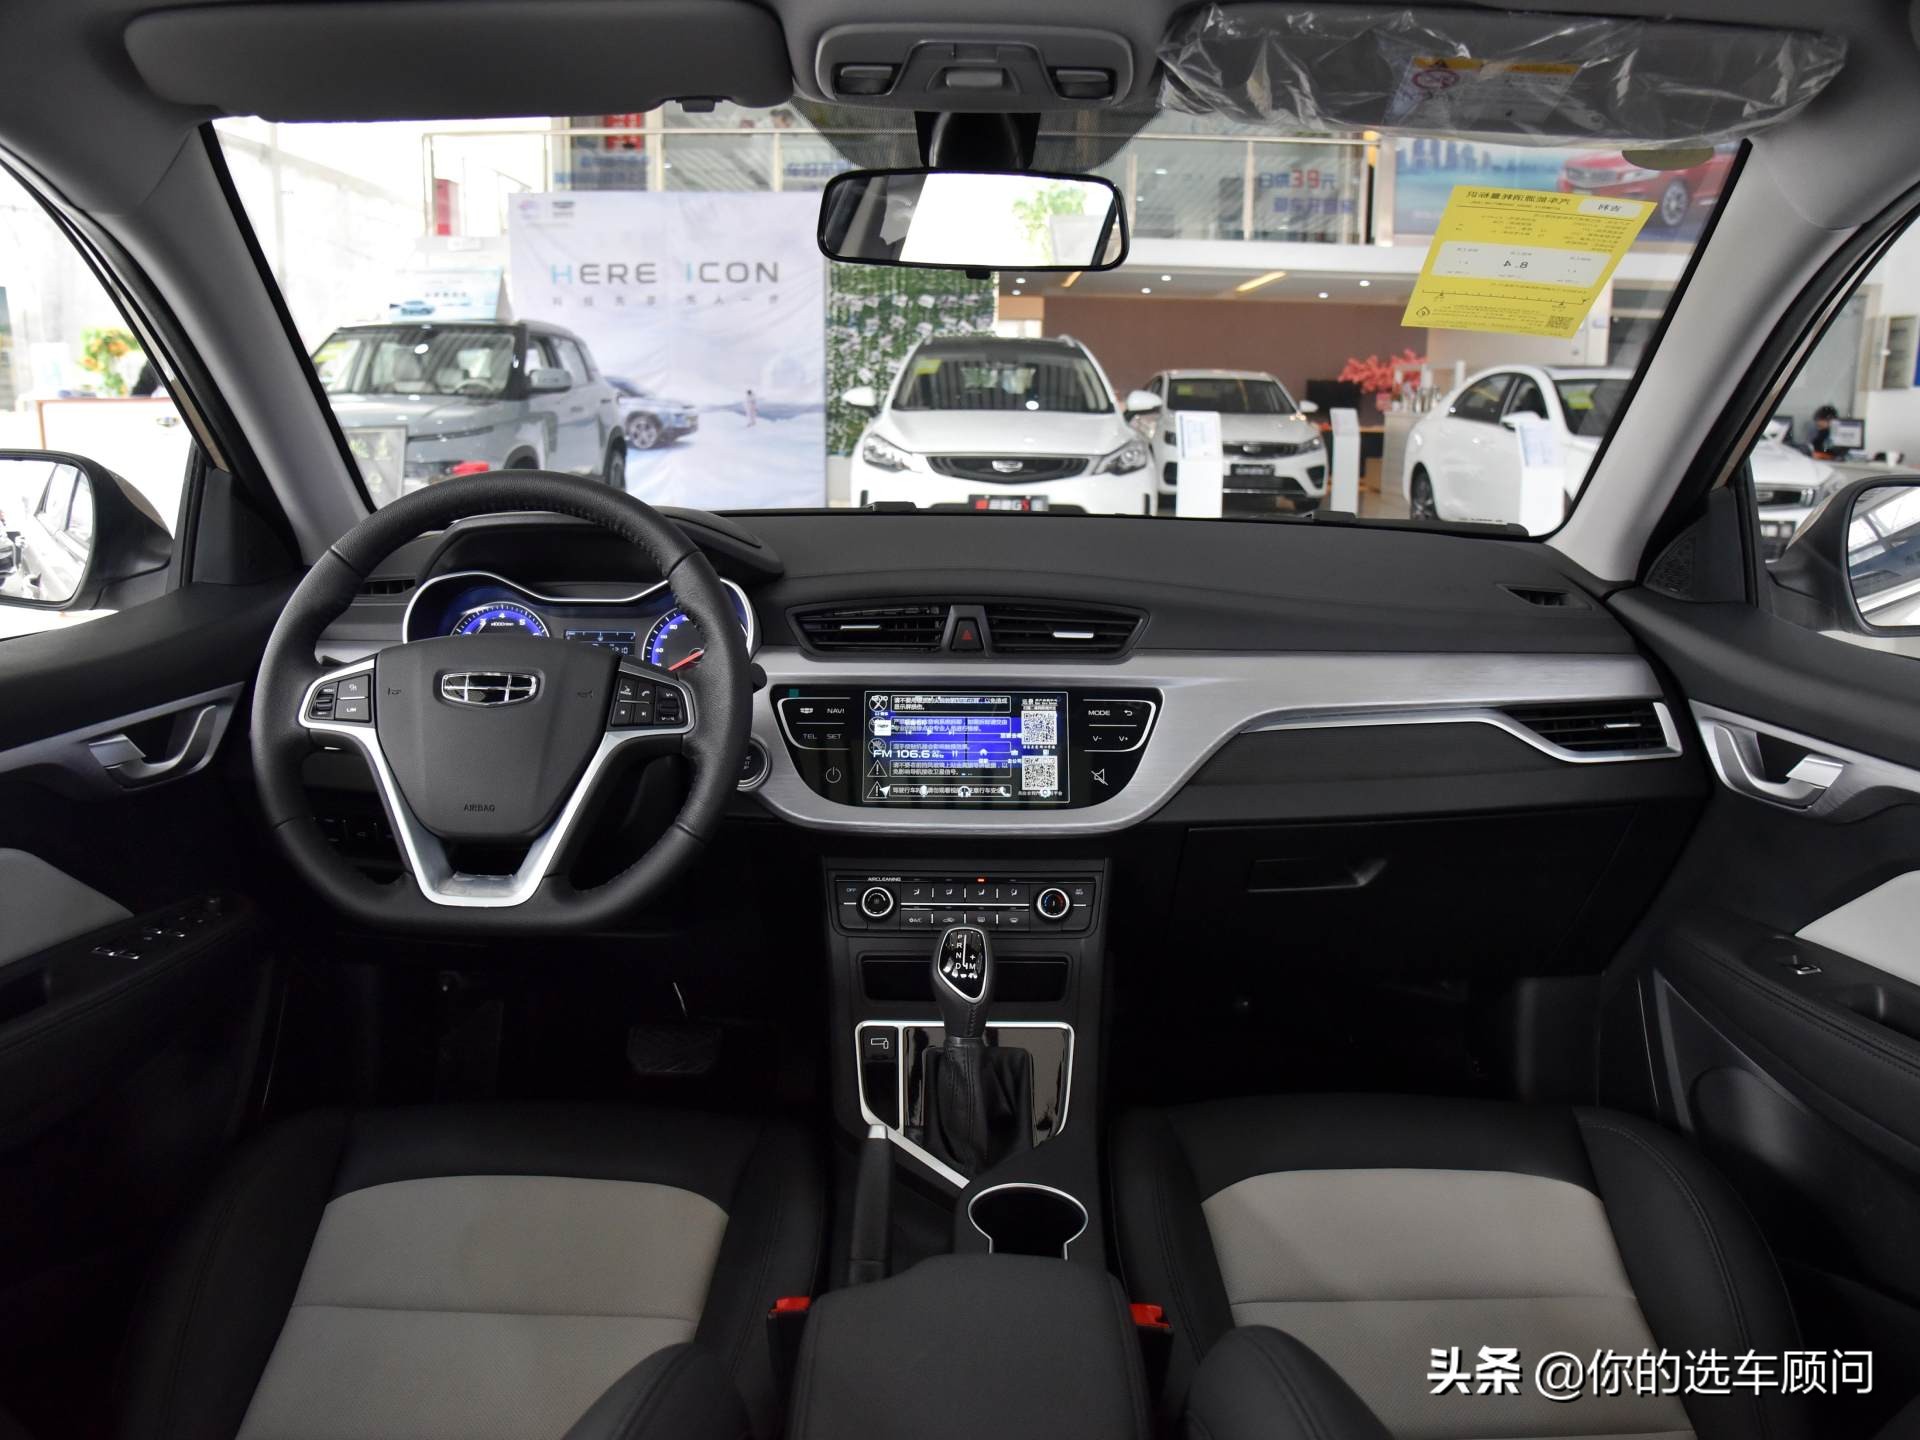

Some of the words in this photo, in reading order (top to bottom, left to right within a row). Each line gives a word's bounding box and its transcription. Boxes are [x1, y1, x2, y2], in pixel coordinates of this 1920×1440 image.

[550, 262, 657, 285] HERE
[685, 260, 779, 283] ICON
[873, 749, 892, 758] FM
[896, 749, 930, 758] 106.6
[955, 962, 961, 970] D
[969, 962, 976, 970] M
